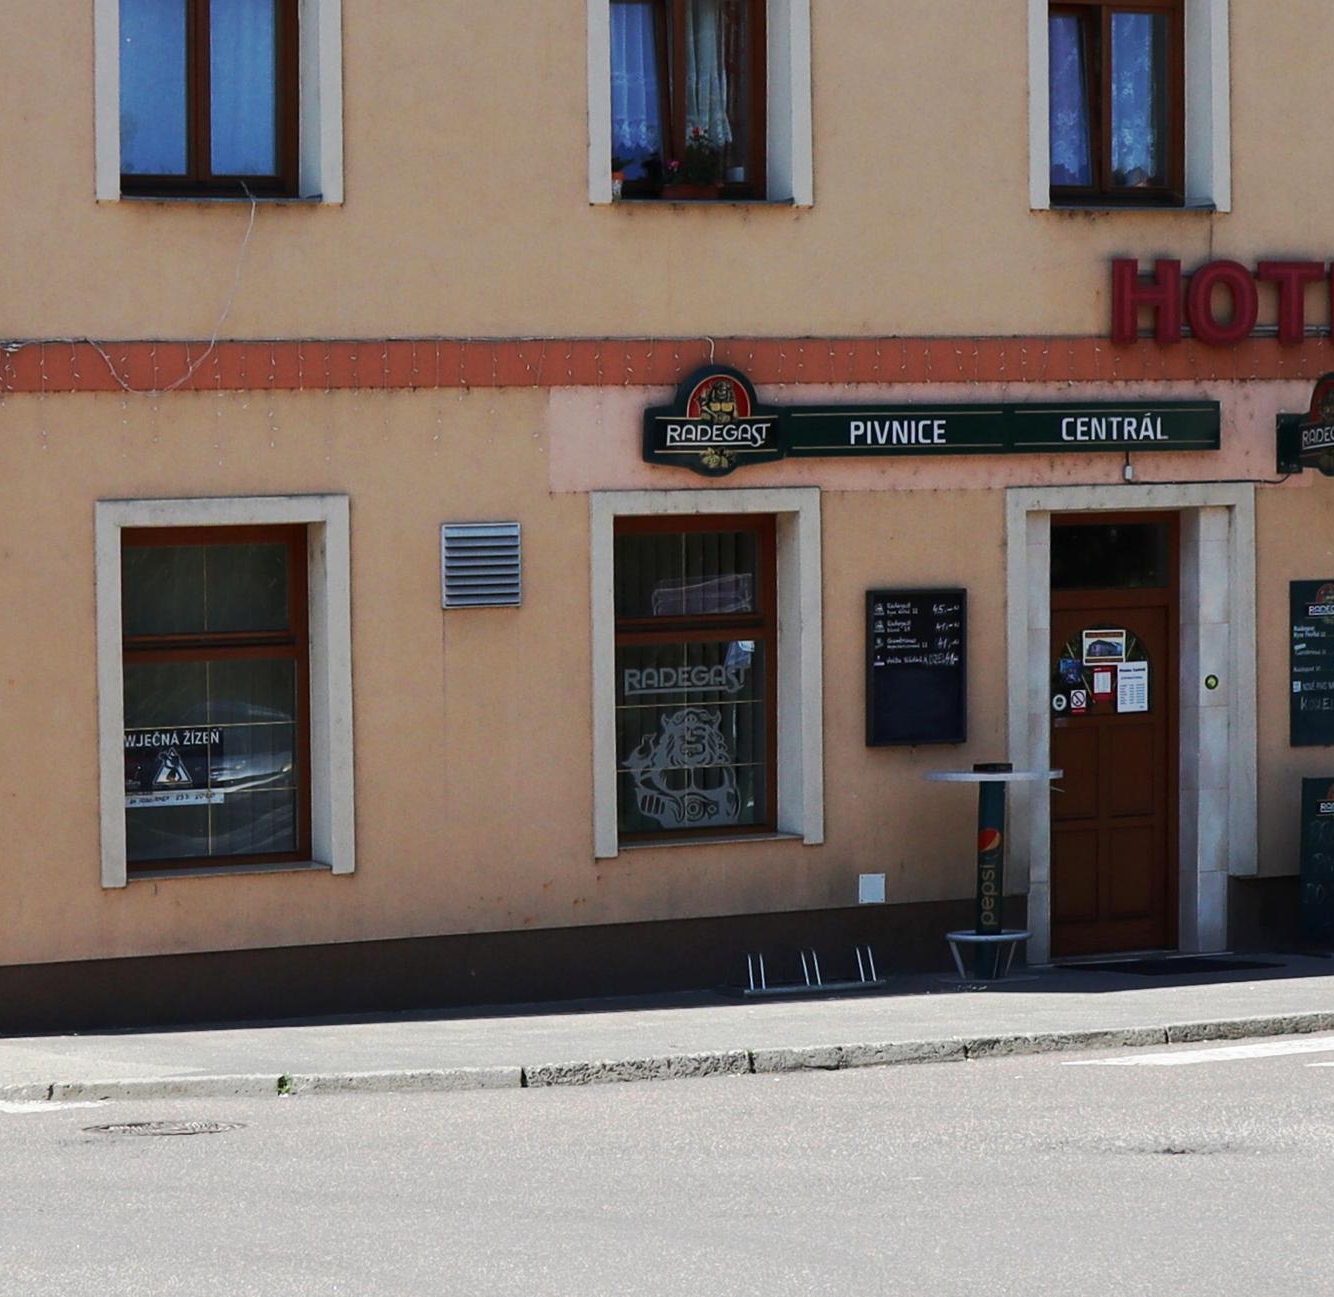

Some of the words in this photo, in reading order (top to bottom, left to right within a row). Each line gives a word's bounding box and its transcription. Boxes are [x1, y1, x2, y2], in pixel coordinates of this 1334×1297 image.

[667, 423, 770, 447] RADEGAST
[849, 419, 947, 445] PIVNICE
[1061, 412, 1169, 442] CENTRÁL
[624, 665, 747, 696] RADEGAST
[980, 864, 999, 926] pepsi
